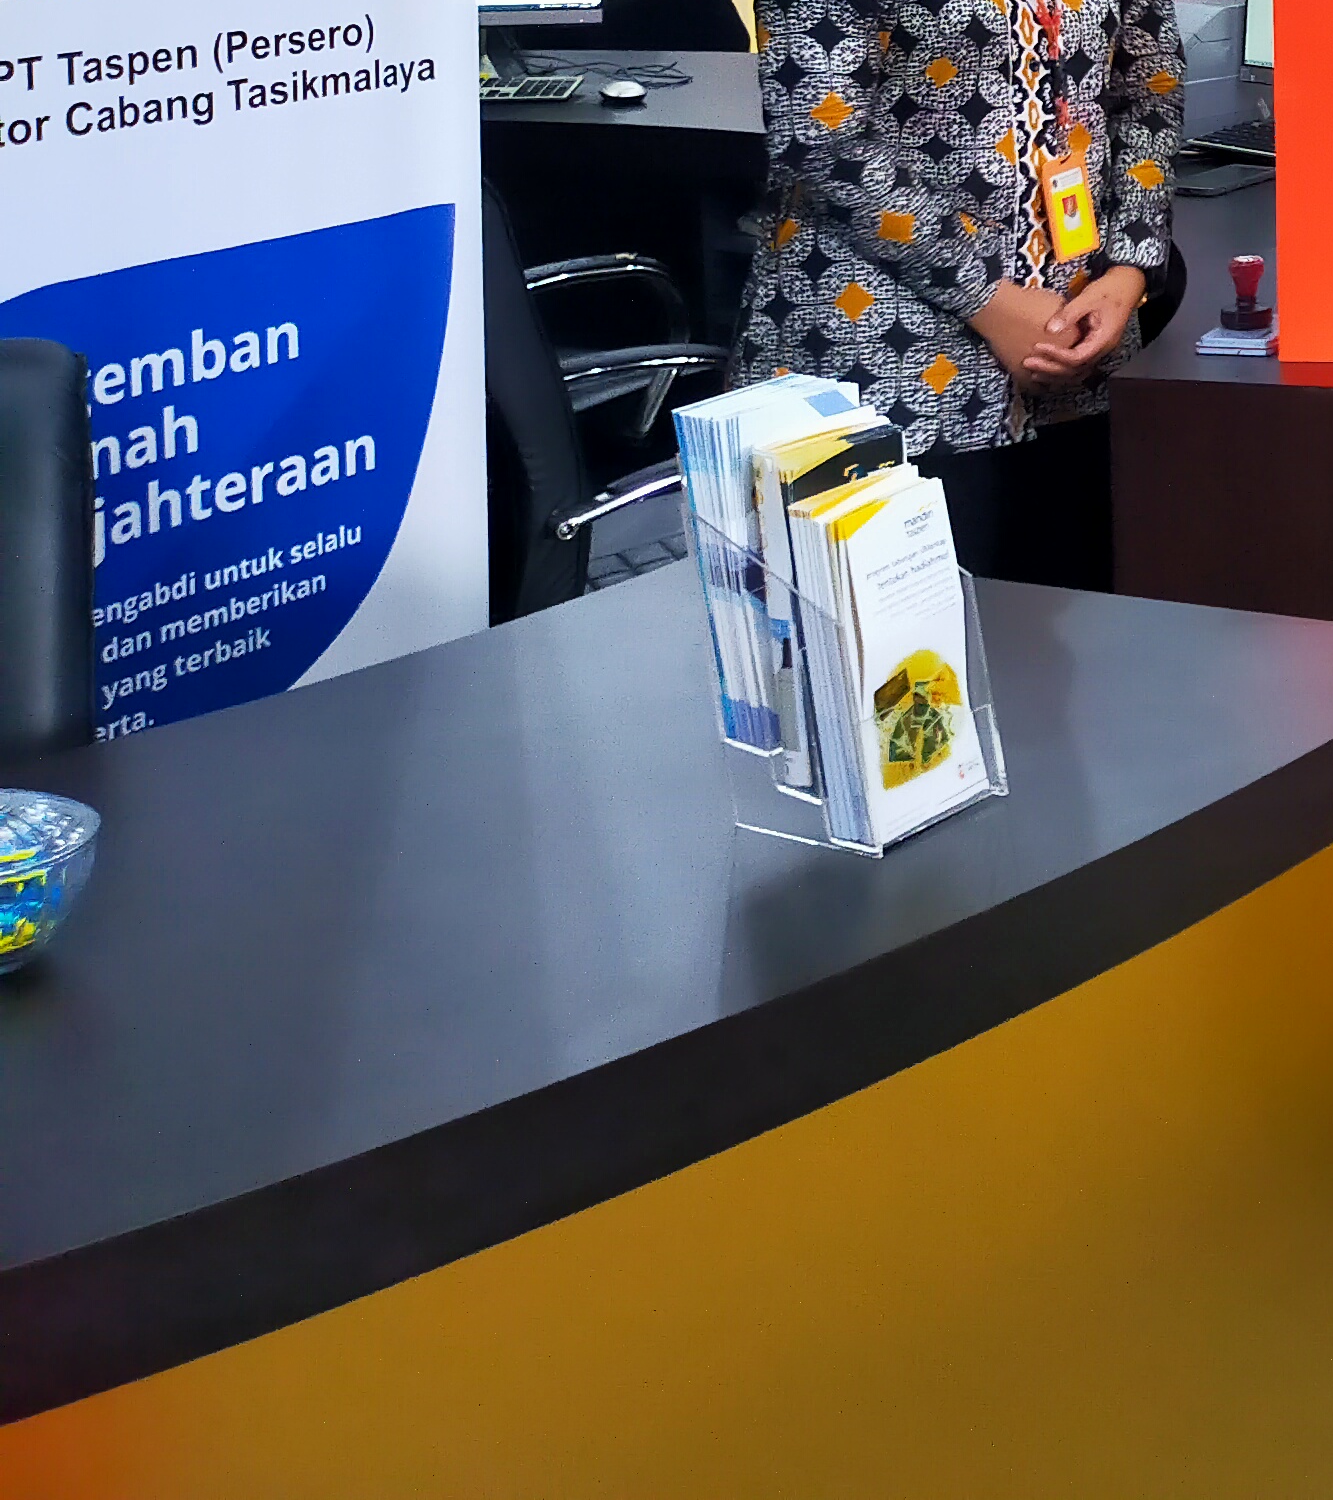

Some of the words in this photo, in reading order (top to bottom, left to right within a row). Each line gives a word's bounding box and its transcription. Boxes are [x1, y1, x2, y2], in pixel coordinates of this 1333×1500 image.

[57, 43, 198, 85] Taspen
[213, 14, 374, 73] (Persero)
[66, 90, 215, 136] Cabang
[226, 57, 436, 111] Tasikmalaya
[86, 321, 300, 417] emban
[93, 433, 377, 569] jahteraan
[91, 571, 197, 627] engabdi
[204, 547, 284, 591] untuk
[290, 525, 362, 564] selalu
[101, 631, 152, 664] dan
[160, 574, 327, 643] memberikan
[101, 663, 168, 711] yang
[174, 627, 273, 677] terbaik
